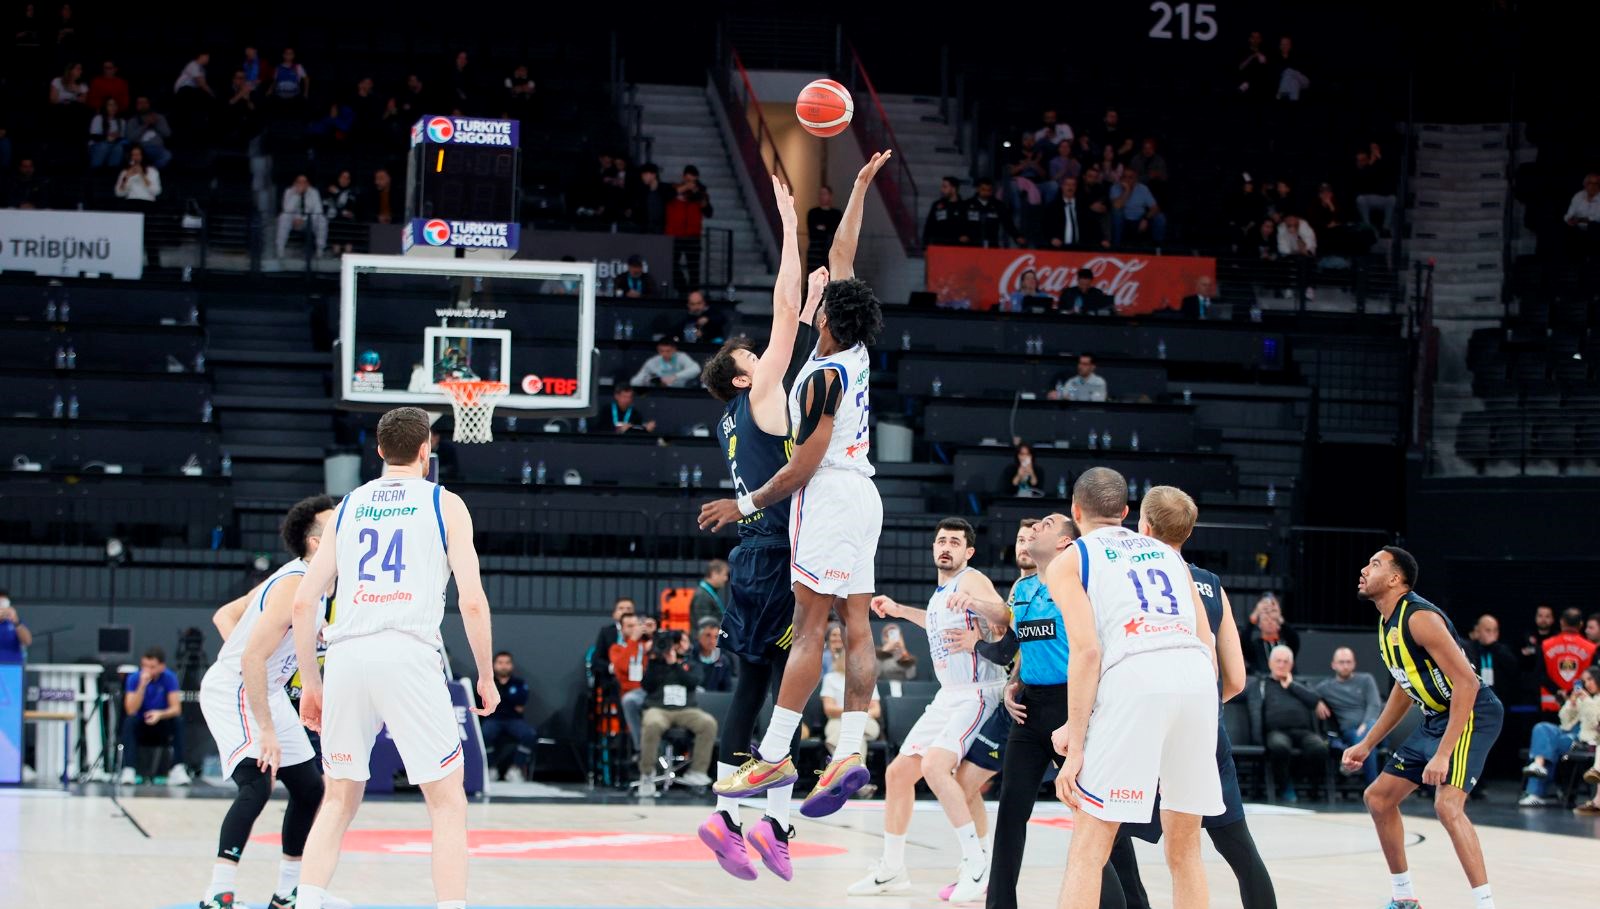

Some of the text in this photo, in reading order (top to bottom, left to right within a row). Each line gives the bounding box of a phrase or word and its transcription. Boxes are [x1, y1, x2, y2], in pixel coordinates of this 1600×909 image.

[1149, 1, 1218, 41] 215
[9, 235, 111, 260] TRİBÜNÜ
[543, 377, 577, 395] TBF
[372, 490, 406, 502] ERCAN
[354, 504, 418, 522] Bilyoner
[358, 528, 406, 583] 24
[825, 569, 850, 581] HSM
[1126, 568, 1179, 616] 13
[331, 752, 353, 763] HSM
[1110, 789, 1144, 800] HSM
